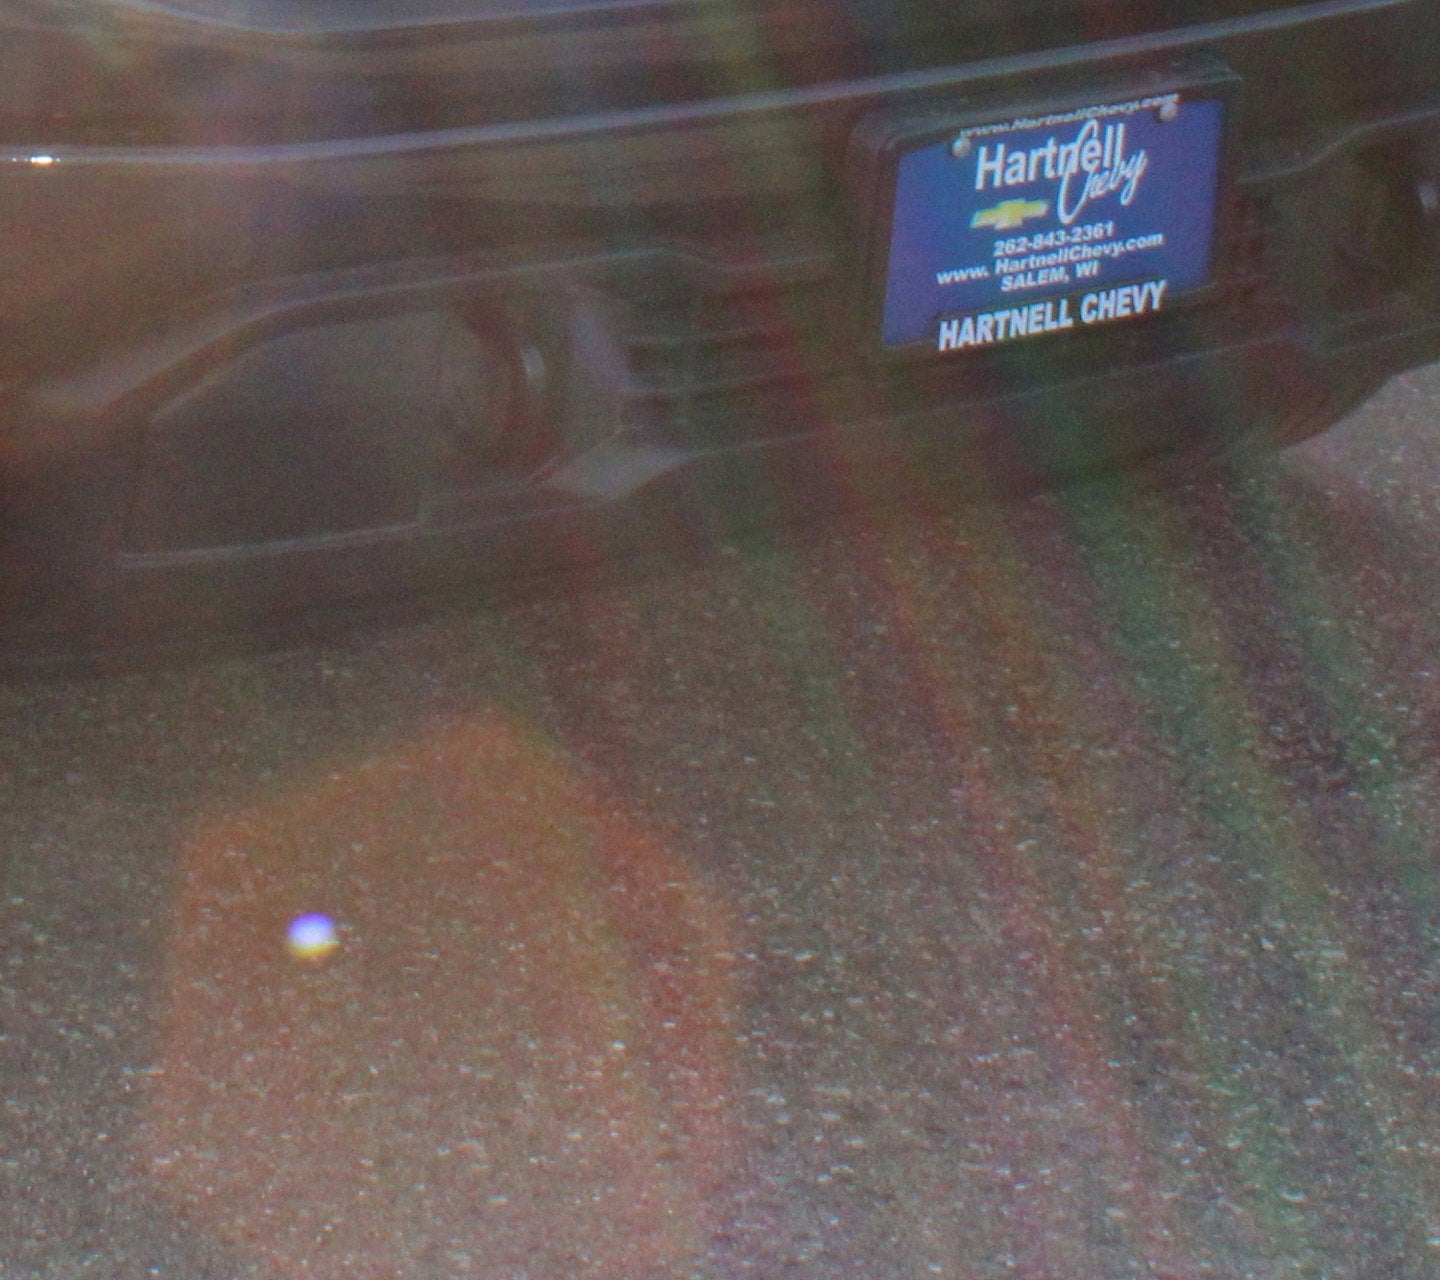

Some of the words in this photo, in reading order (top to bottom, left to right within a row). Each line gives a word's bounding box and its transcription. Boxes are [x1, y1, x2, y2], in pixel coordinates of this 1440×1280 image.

[975, 122, 1125, 190] Hartnell
[993, 220, 1114, 257] 262-843-2361
[994, 233, 1164, 274] HartnellChevy.com
[1000, 266, 1069, 292] SALEM,
[1075, 260, 1099, 278] WI
[938, 297, 1073, 351] HARTNELL
[1080, 279, 1167, 324] CHEVY
